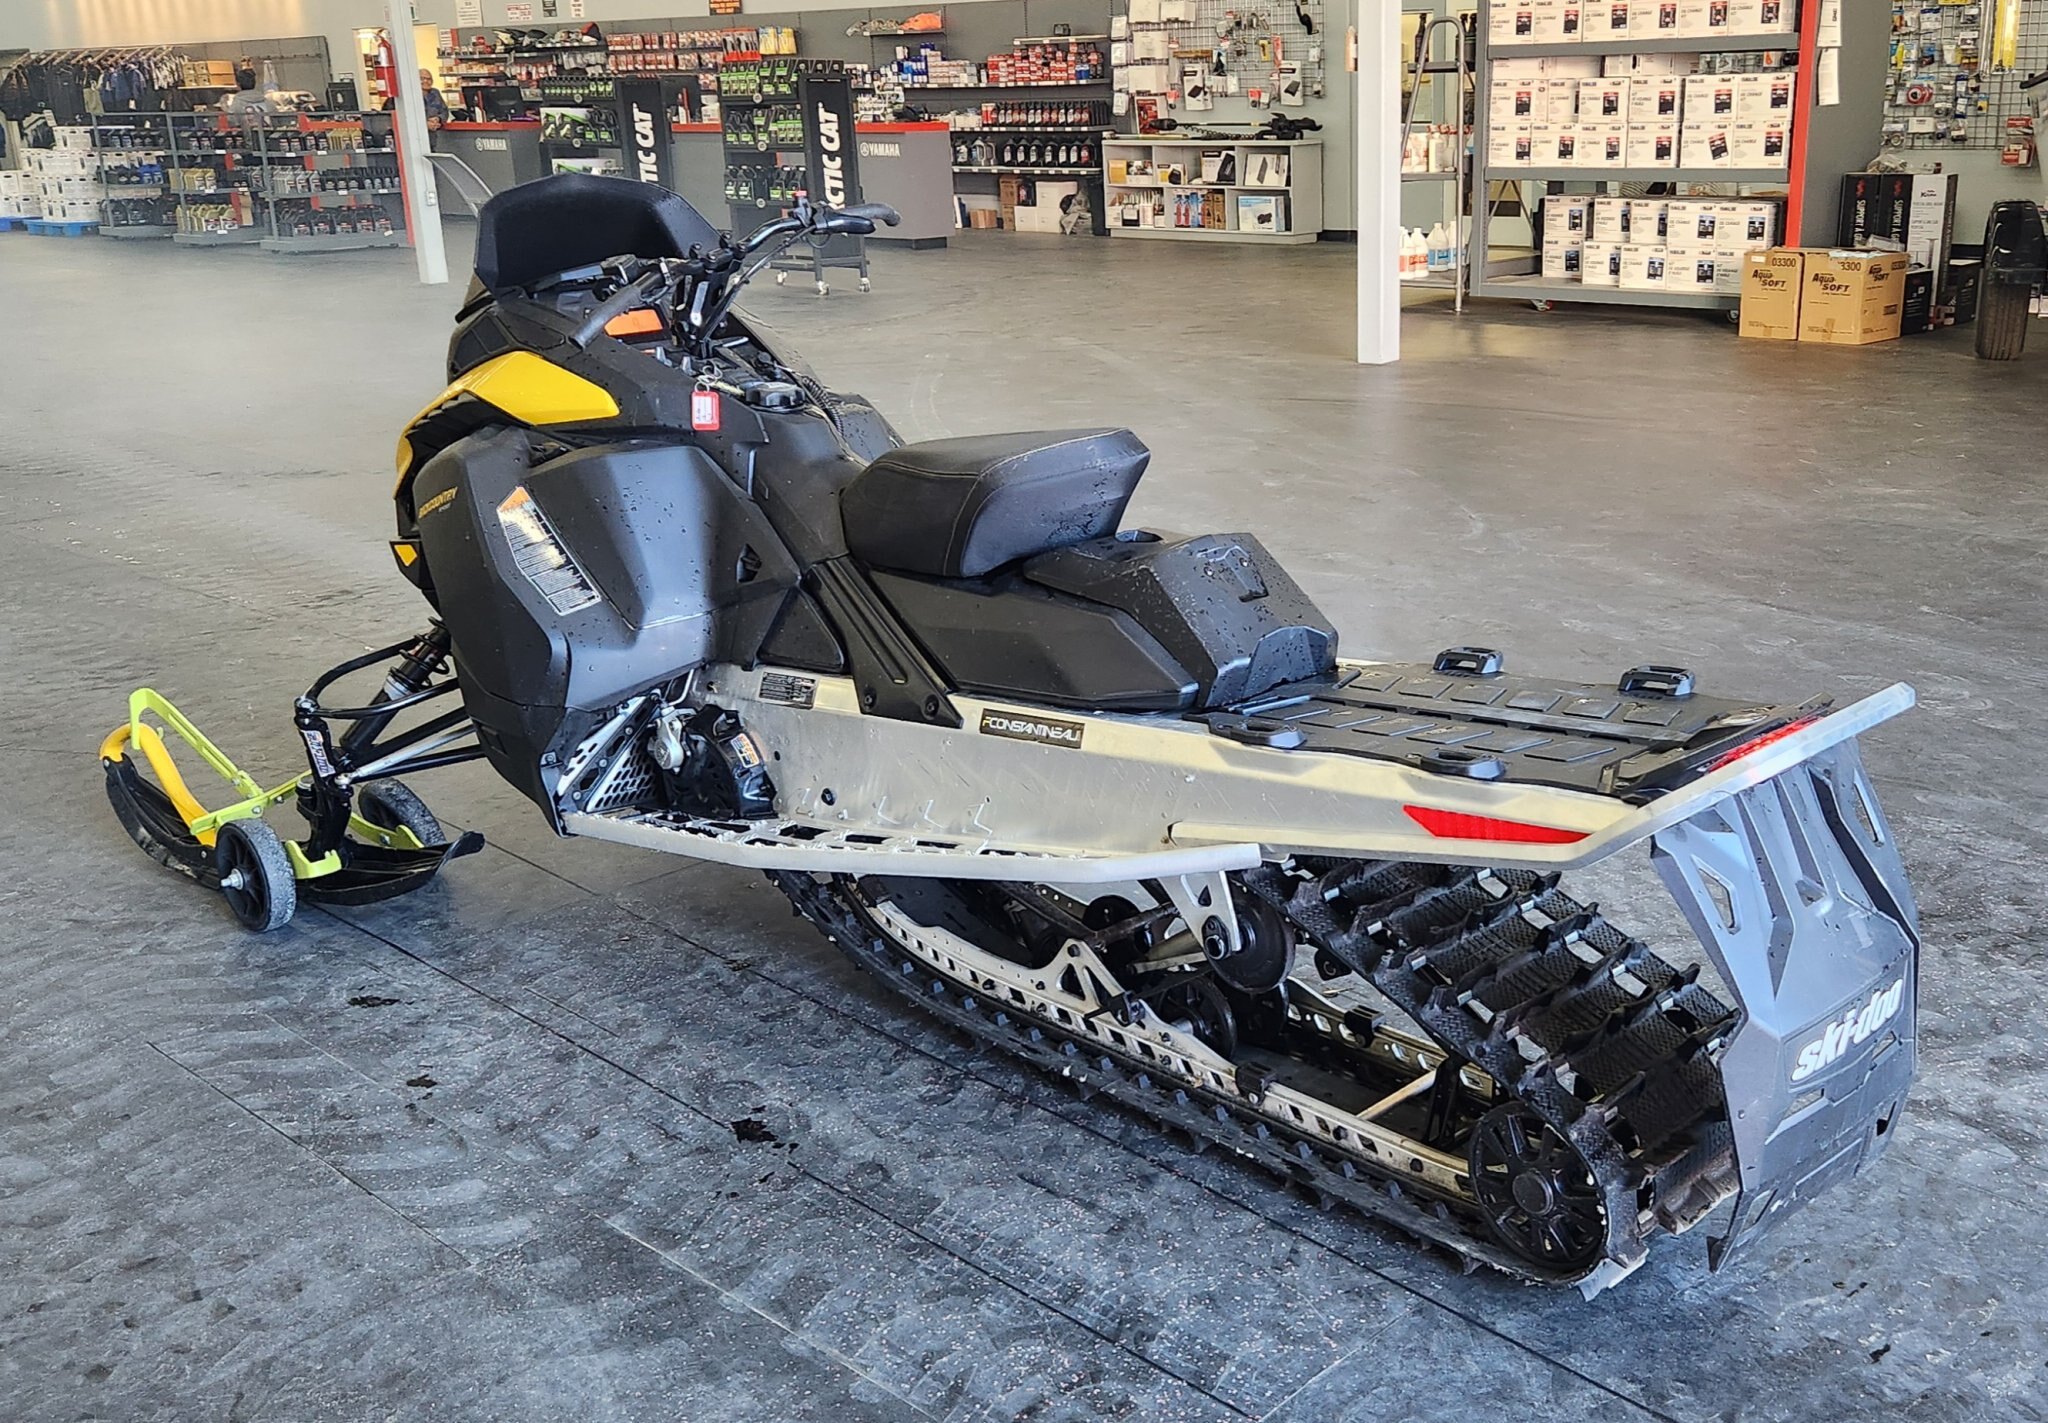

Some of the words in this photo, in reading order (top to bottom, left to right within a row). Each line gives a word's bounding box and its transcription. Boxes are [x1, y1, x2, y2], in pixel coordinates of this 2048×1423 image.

[632, 105, 655, 148] CAT
[818, 105, 841, 152] CAT
[482, 138, 507, 151] YAMAHA
[869, 143, 901, 157] YAMAHA
[637, 149, 659, 183] TIC
[822, 153, 846, 211] CTIC
[1855, 199, 1867, 226] SUPPORT
[1892, 199, 1904, 226] SUPPORT
[1772, 257, 1797, 268] 03300
[1837, 261, 1862, 272] 3300
[1761, 279, 1787, 288] SOFT
[1821, 283, 1851, 293] SOFT
